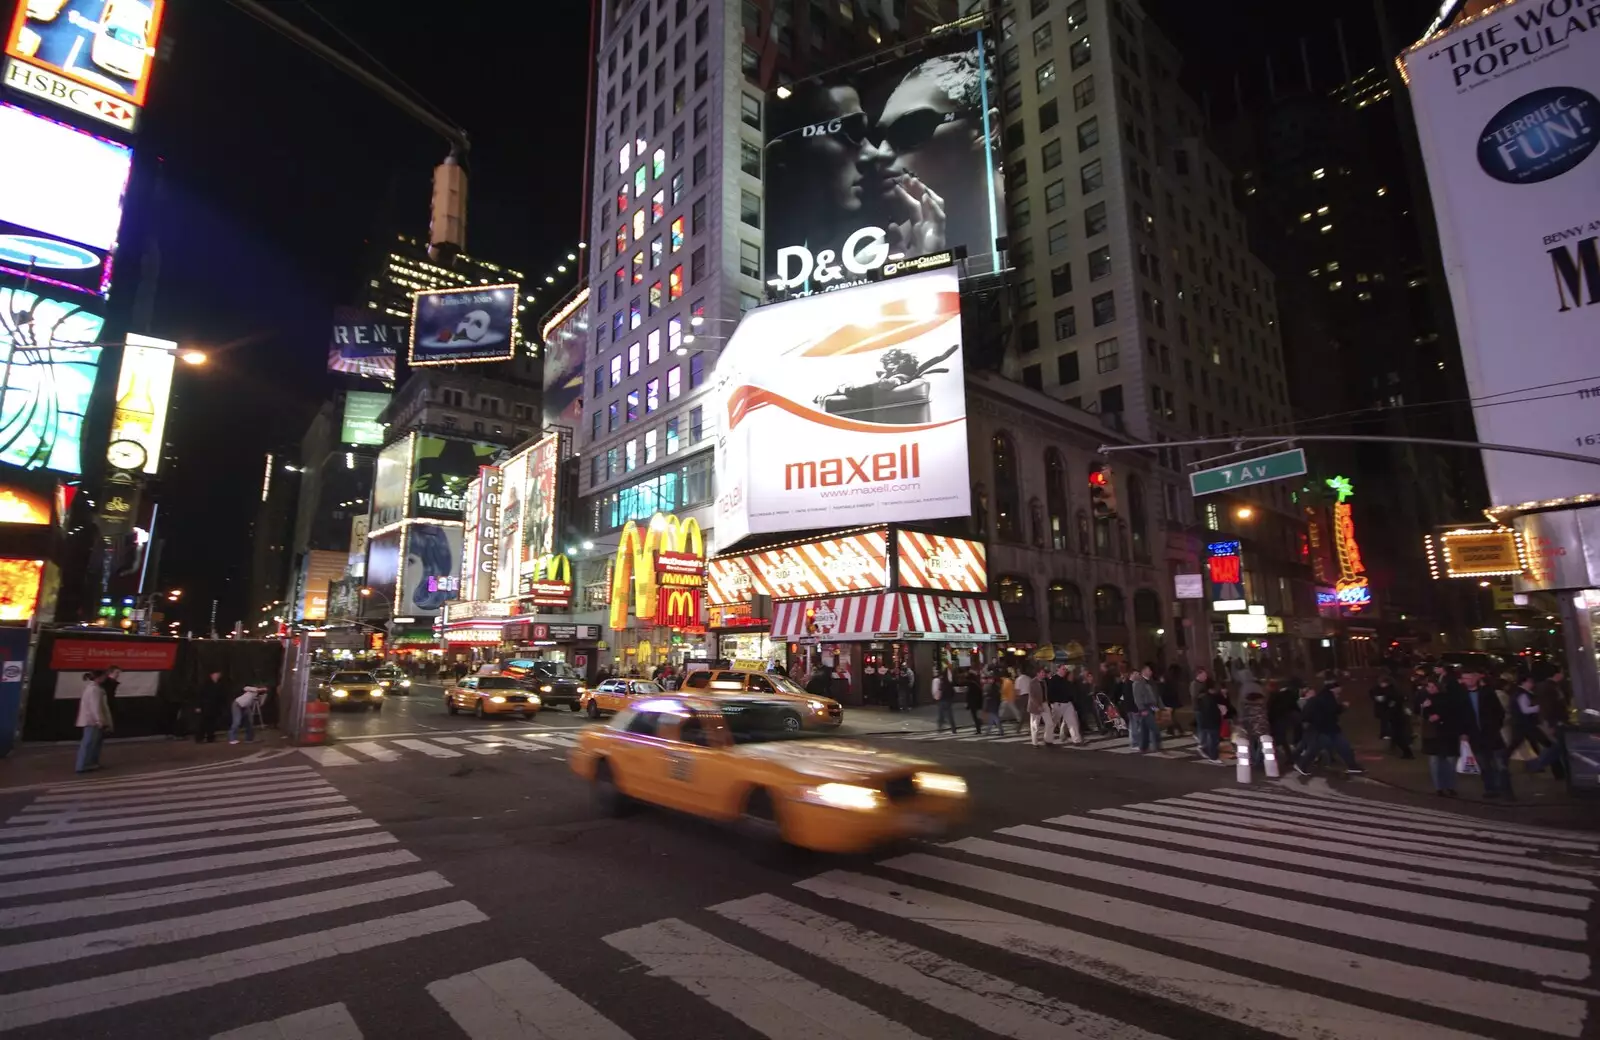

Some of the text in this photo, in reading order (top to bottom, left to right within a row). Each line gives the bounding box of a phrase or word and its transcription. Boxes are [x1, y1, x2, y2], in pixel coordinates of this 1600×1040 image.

[8, 63, 89, 105] HSBC
[801, 119, 843, 137] D&G
[1542, 224, 1584, 246] BENNY
[766, 225, 890, 291] D&G
[333, 323, 405, 345] RENT
[785, 442, 920, 491] maxell
[1220, 470, 1232, 484] 7
[819, 481, 921, 499] www.maxell.com
[481, 475, 499, 574] PALACE
